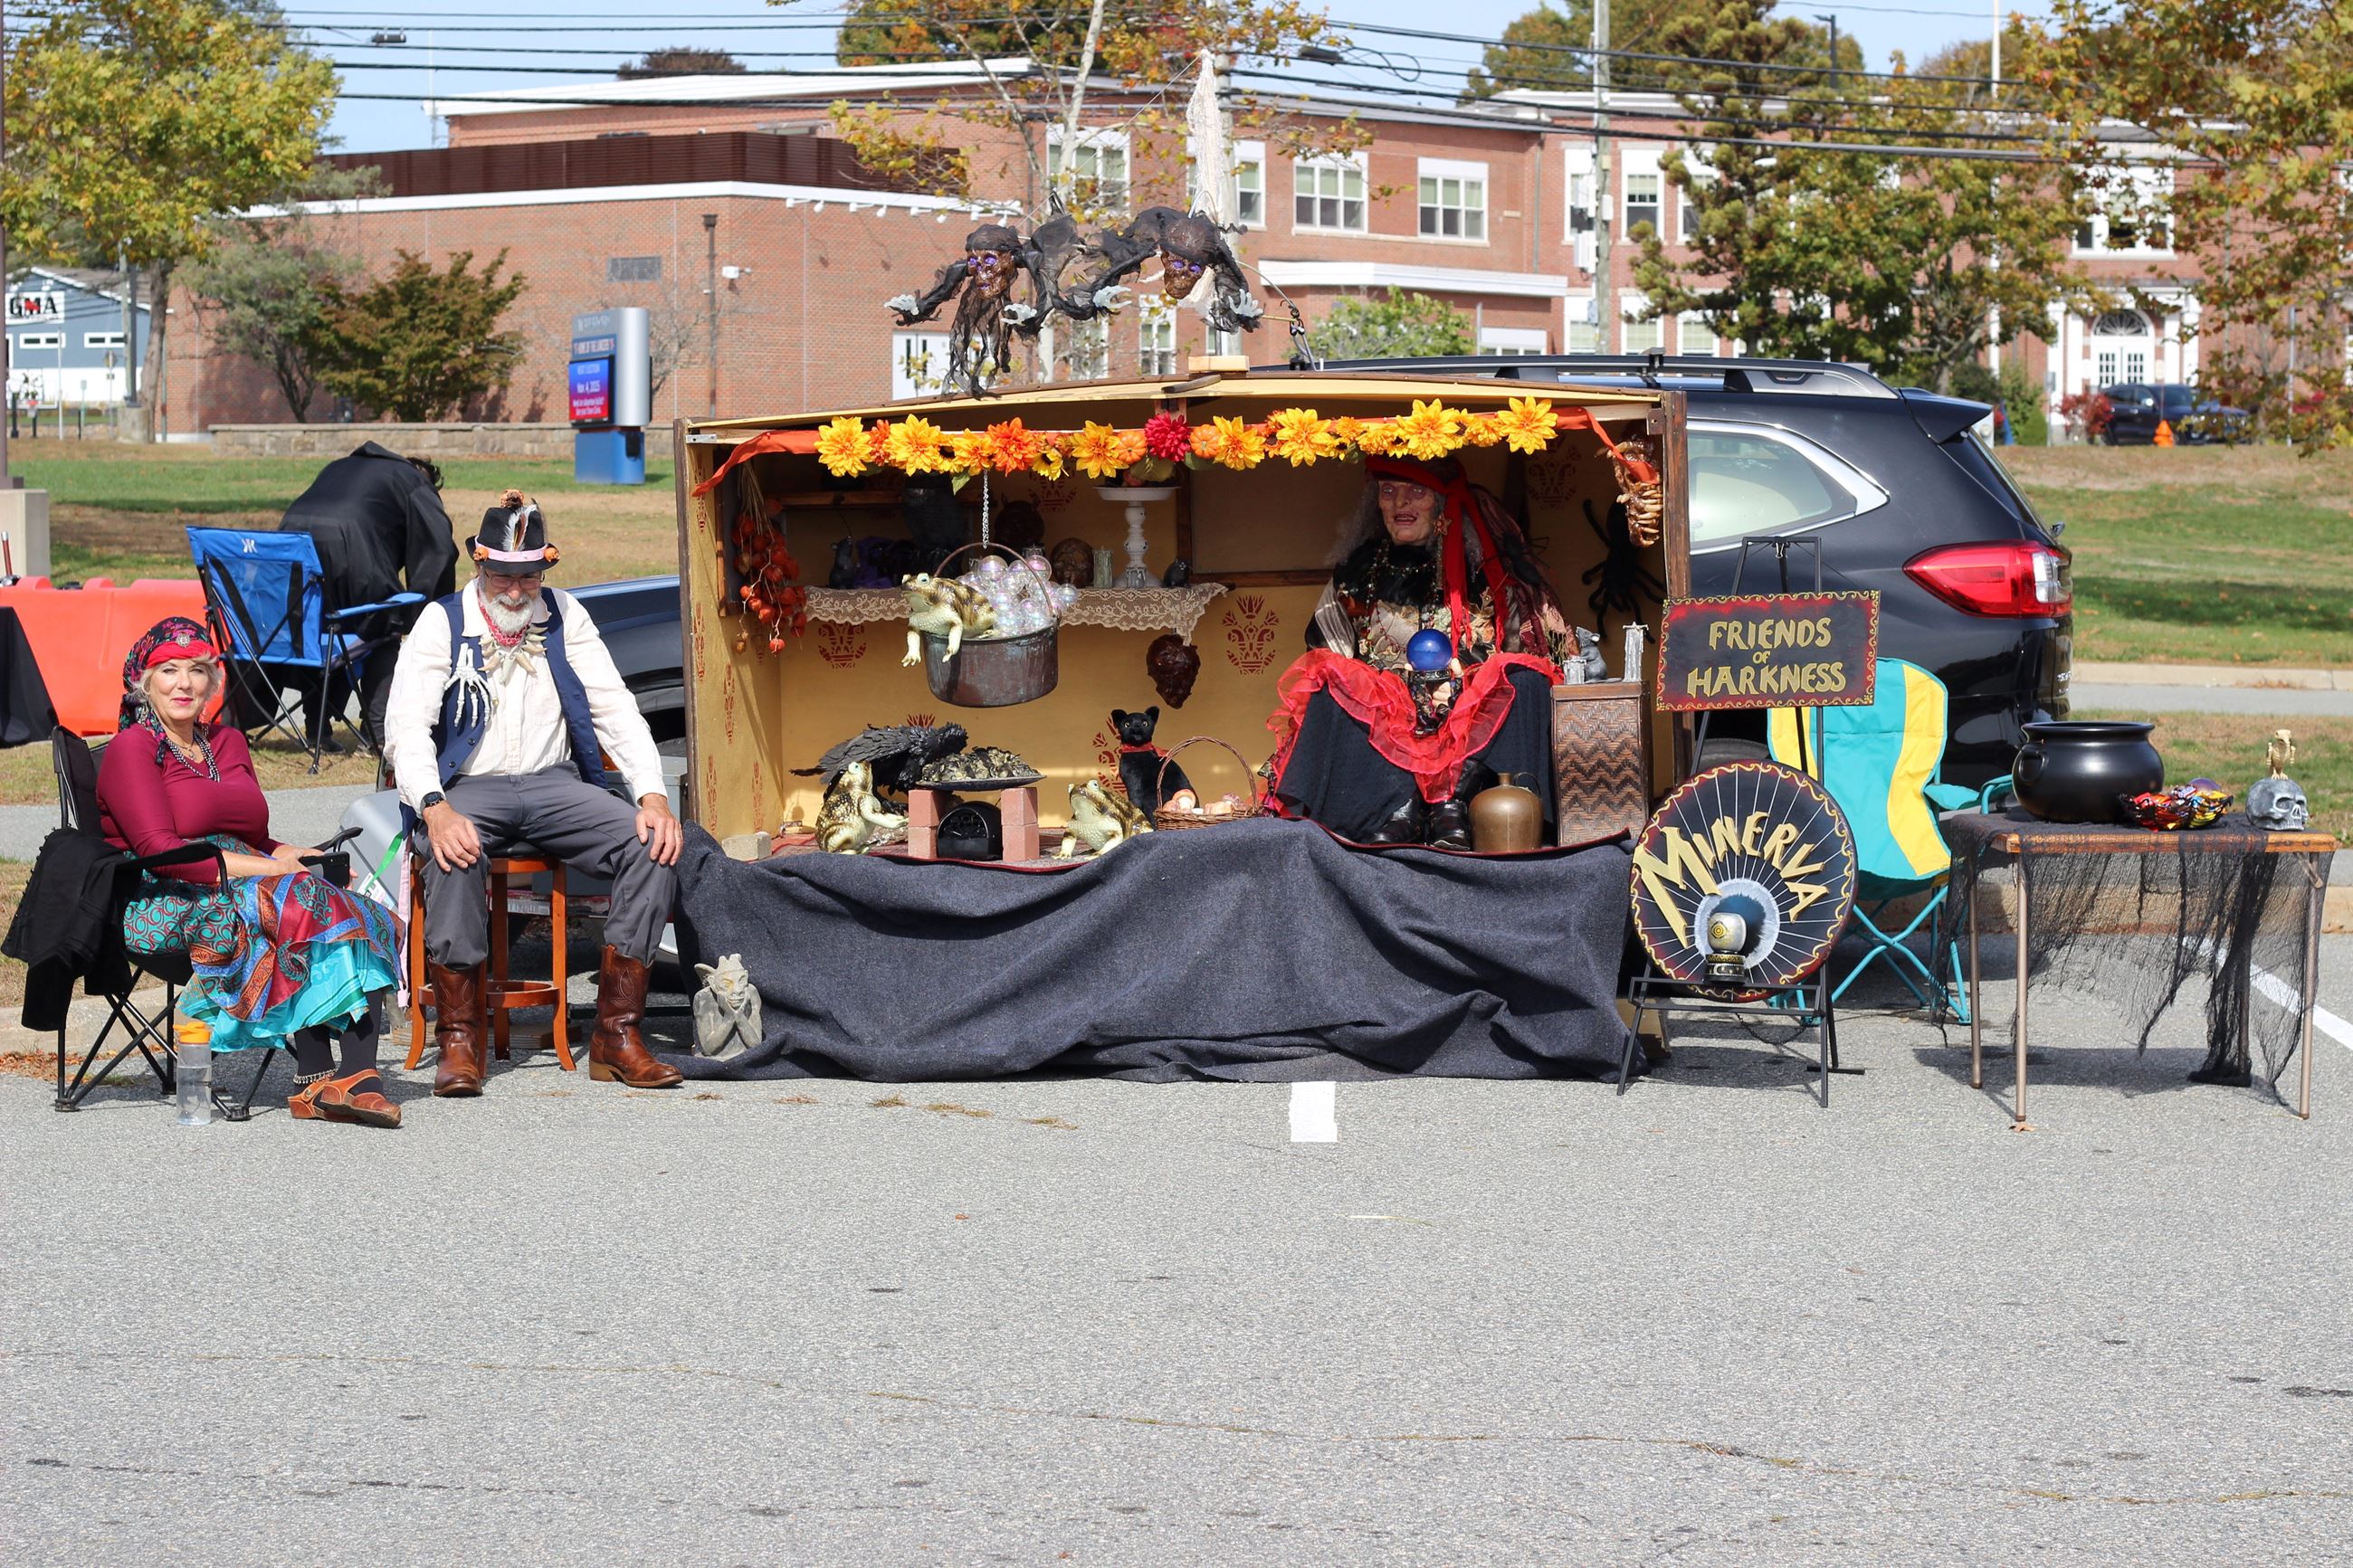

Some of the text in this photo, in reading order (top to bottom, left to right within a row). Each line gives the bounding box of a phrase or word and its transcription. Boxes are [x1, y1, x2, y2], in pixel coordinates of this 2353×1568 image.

[1709, 617, 1832, 651] FRIENDS
[1752, 651, 1771, 664] OF
[1686, 661, 1847, 698] HARKNESS
[1632, 811, 1830, 949] MINERVA
